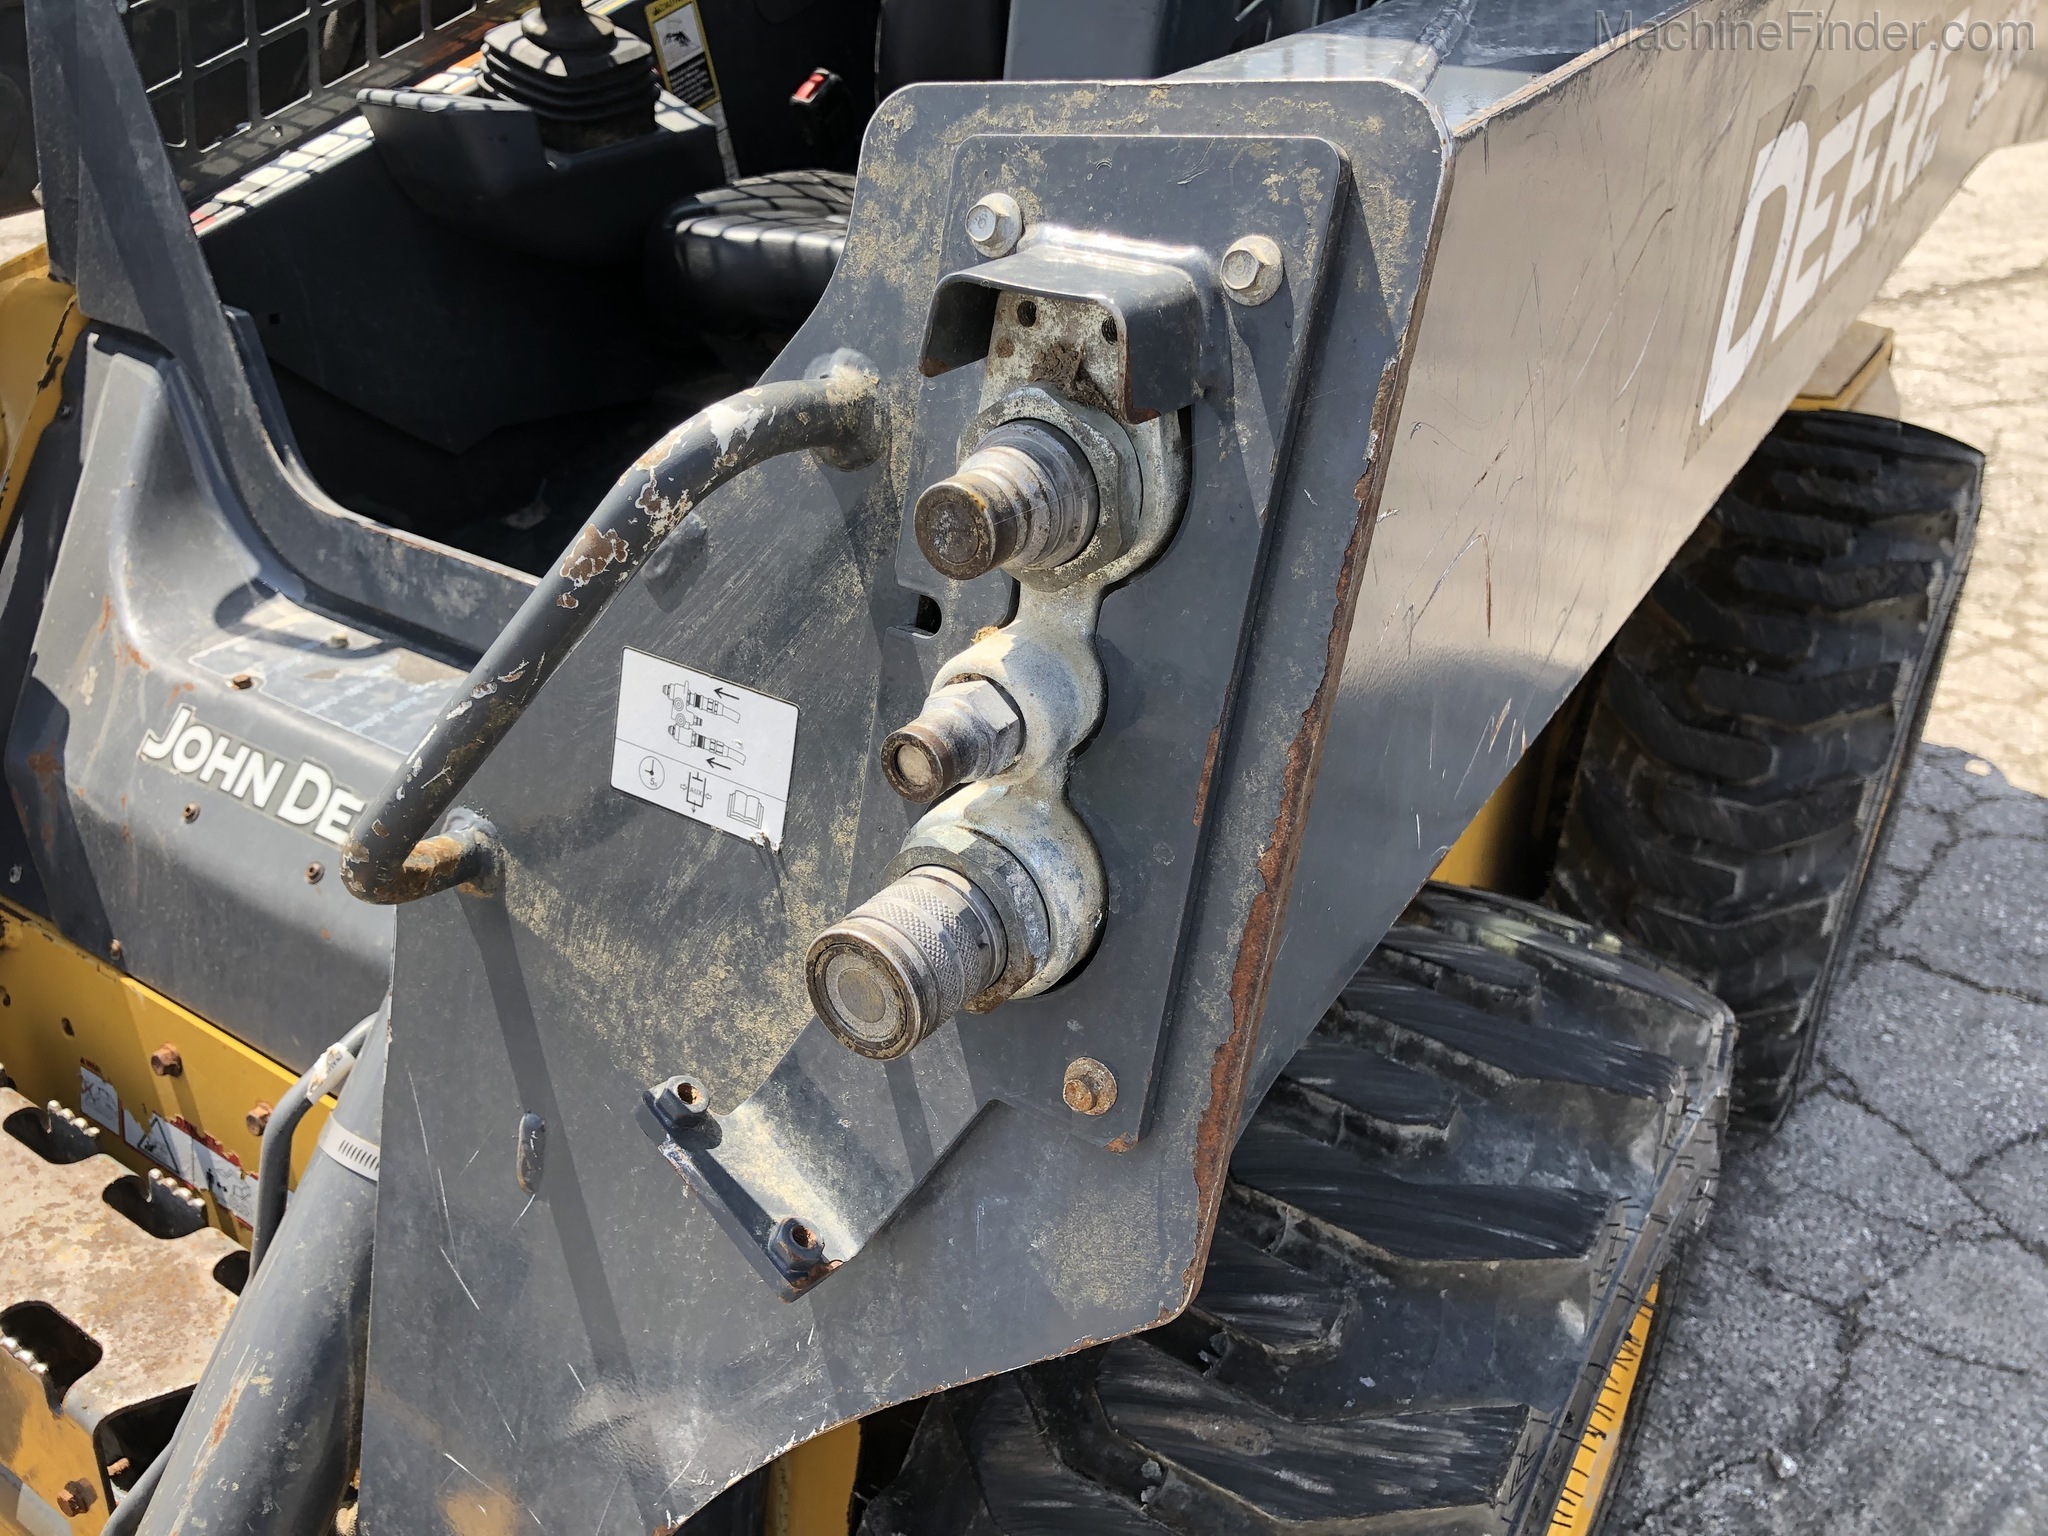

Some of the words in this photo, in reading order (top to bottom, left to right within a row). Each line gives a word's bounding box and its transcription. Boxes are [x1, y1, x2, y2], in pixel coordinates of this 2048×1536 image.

[1699, 6, 1970, 427] DEERE
[140, 706, 286, 809] JOHN
[690, 787, 703, 796] AUX
